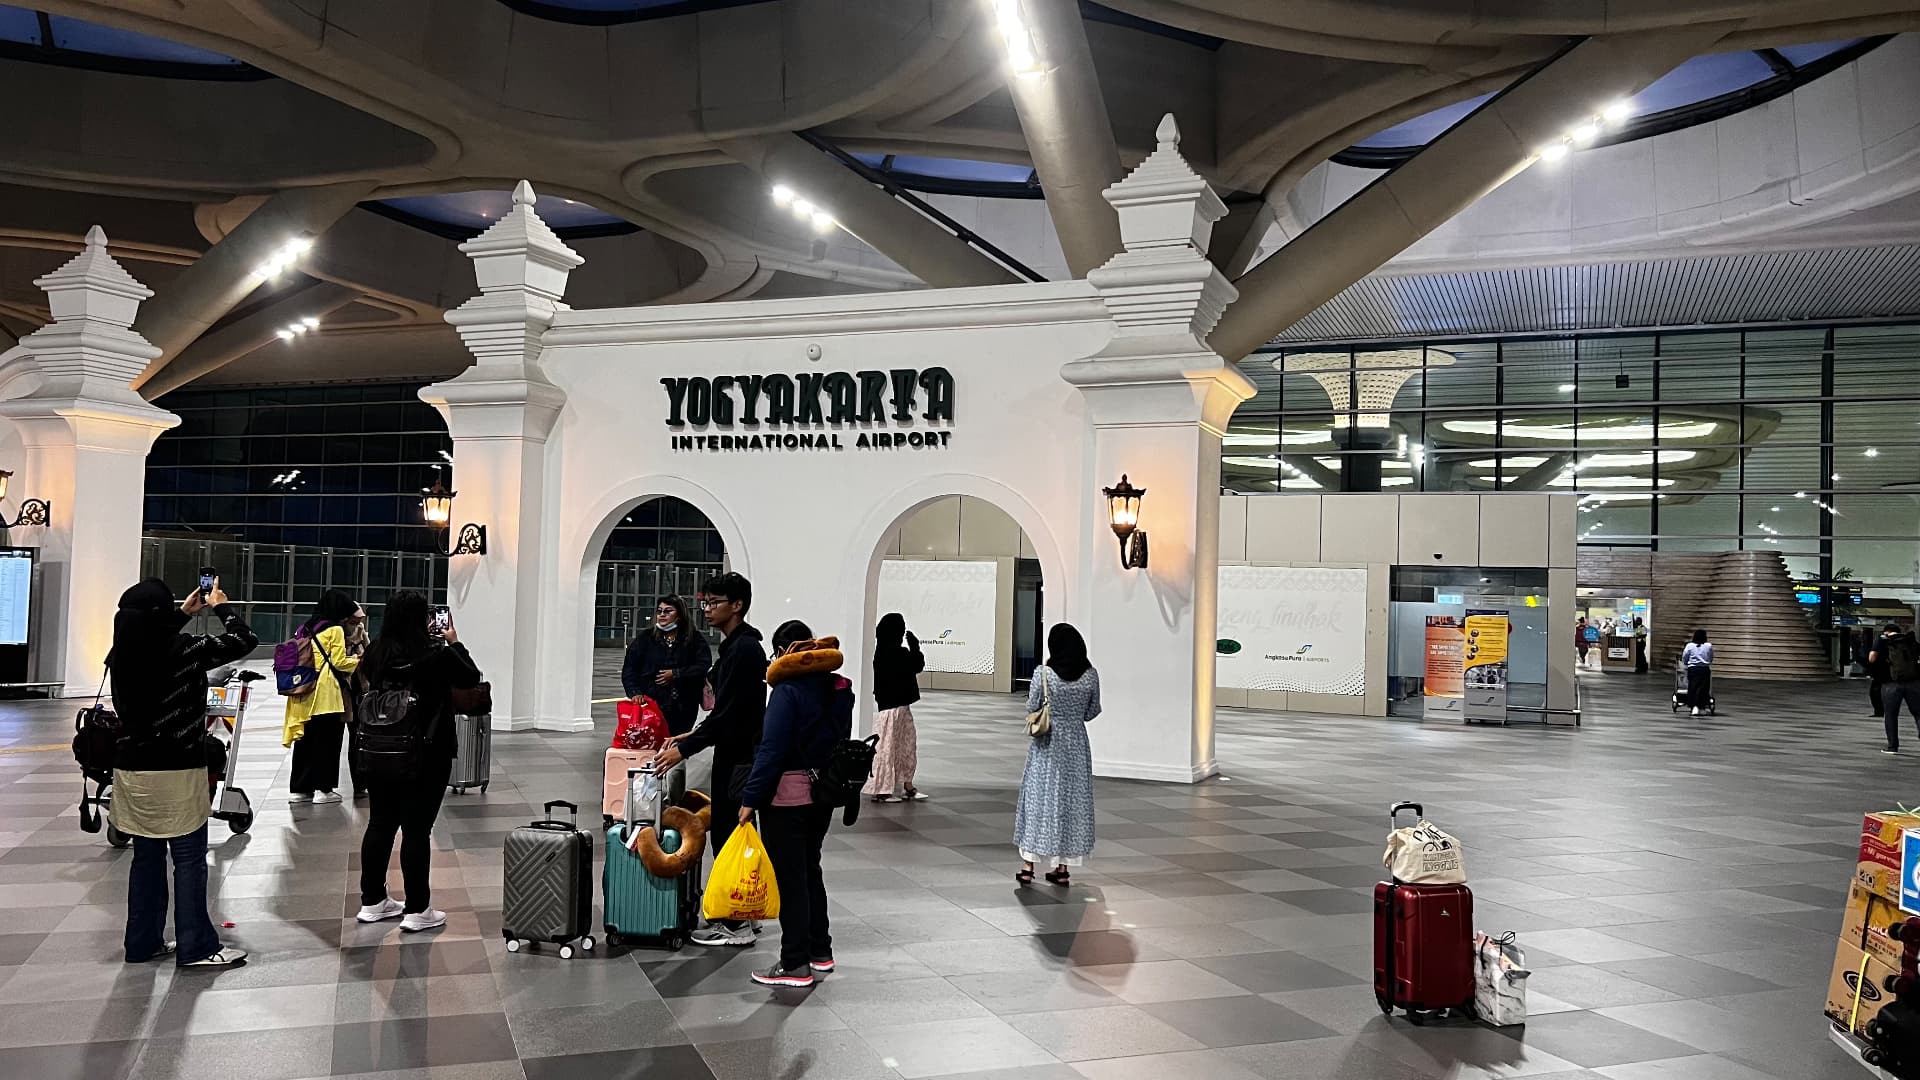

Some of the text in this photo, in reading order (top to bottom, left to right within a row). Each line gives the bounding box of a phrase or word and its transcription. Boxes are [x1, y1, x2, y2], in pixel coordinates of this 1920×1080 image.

[660, 367, 955, 426] YOGYAKARTA
[671, 431, 952, 450] INTERNATIONAL AIRPORT
